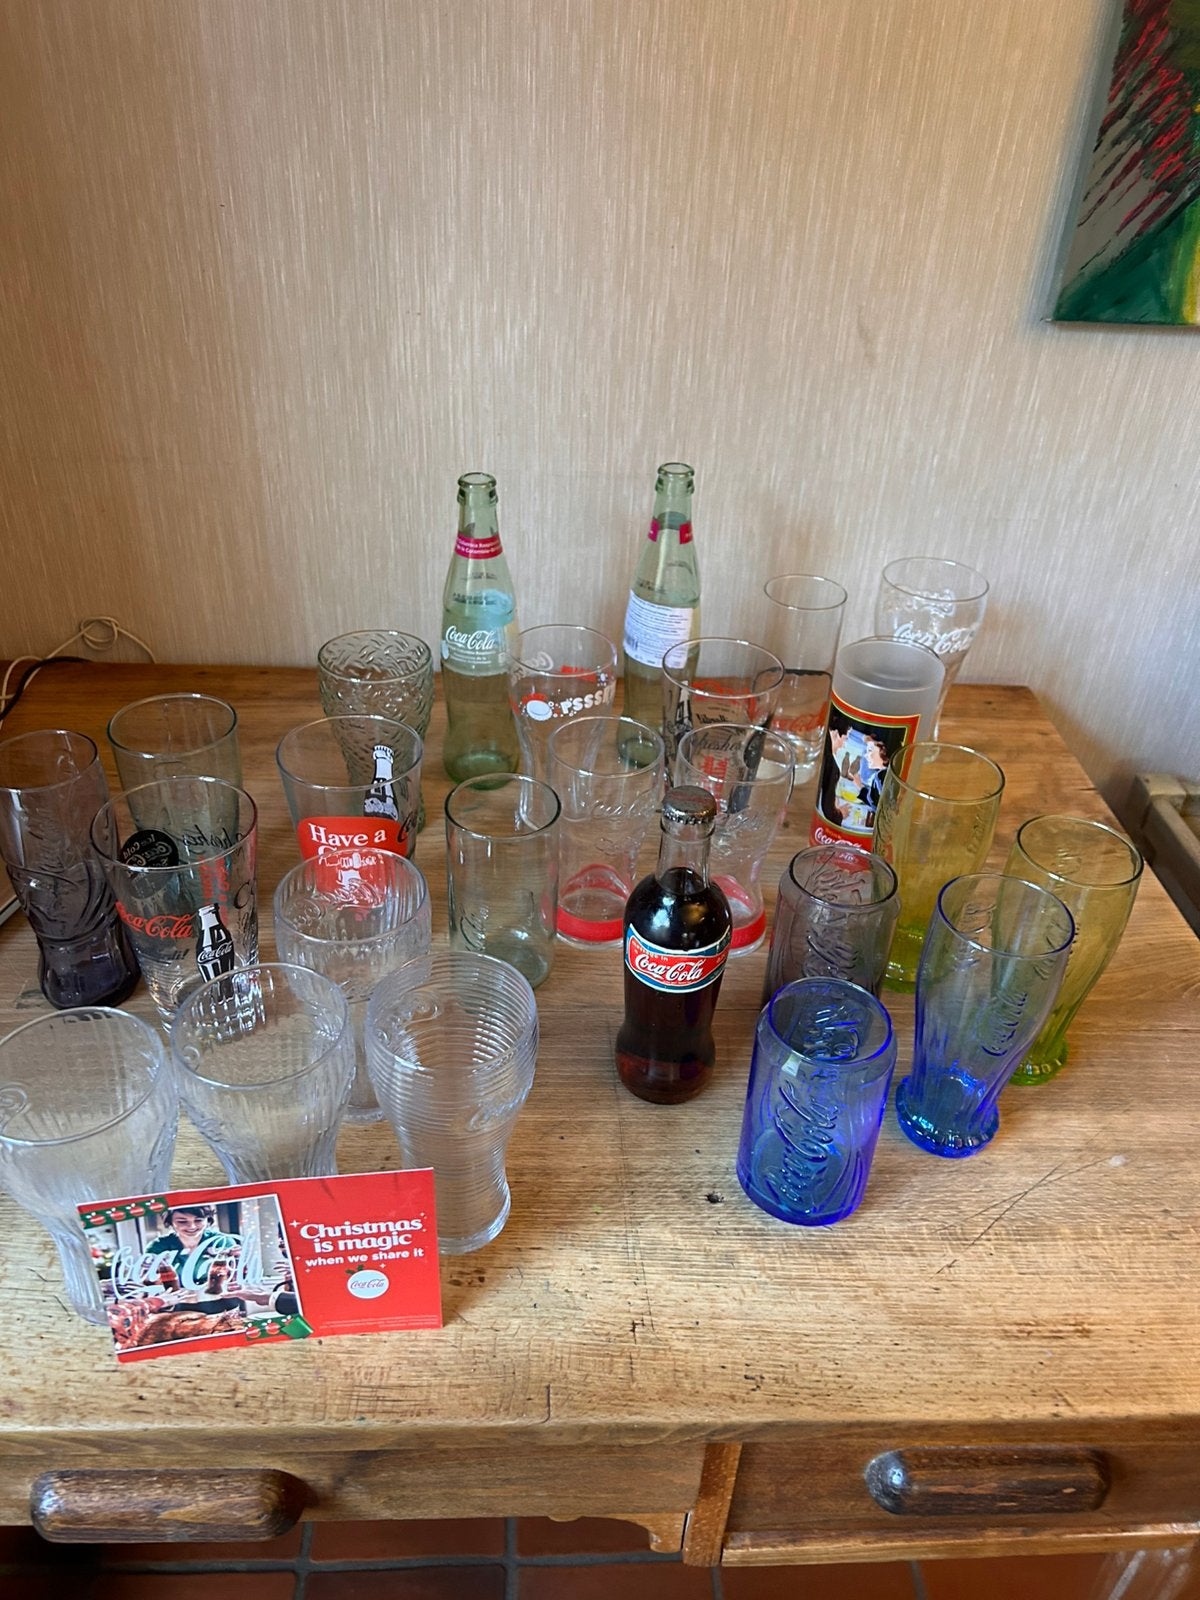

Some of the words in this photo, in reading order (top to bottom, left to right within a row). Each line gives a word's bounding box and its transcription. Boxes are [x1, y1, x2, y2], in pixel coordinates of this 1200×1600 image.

[445, 625, 498, 650] Coca-Cola
[308, 822, 369, 847] Have
[373, 828, 388, 844] a
[197, 940, 234, 963] Coca-Cola
[635, 953, 706, 981] Coca-Cola
[299, 1217, 424, 1240] Christmas
[313, 1237, 334, 1254] is
[337, 1231, 413, 1251] magic
[110, 1231, 266, 1300] Coca-Cola
[305, 1256, 345, 1267] when
[347, 1253, 369, 1263] we
[371, 1250, 410, 1262] share
[350, 1278, 386, 1290] Coca-Cola
